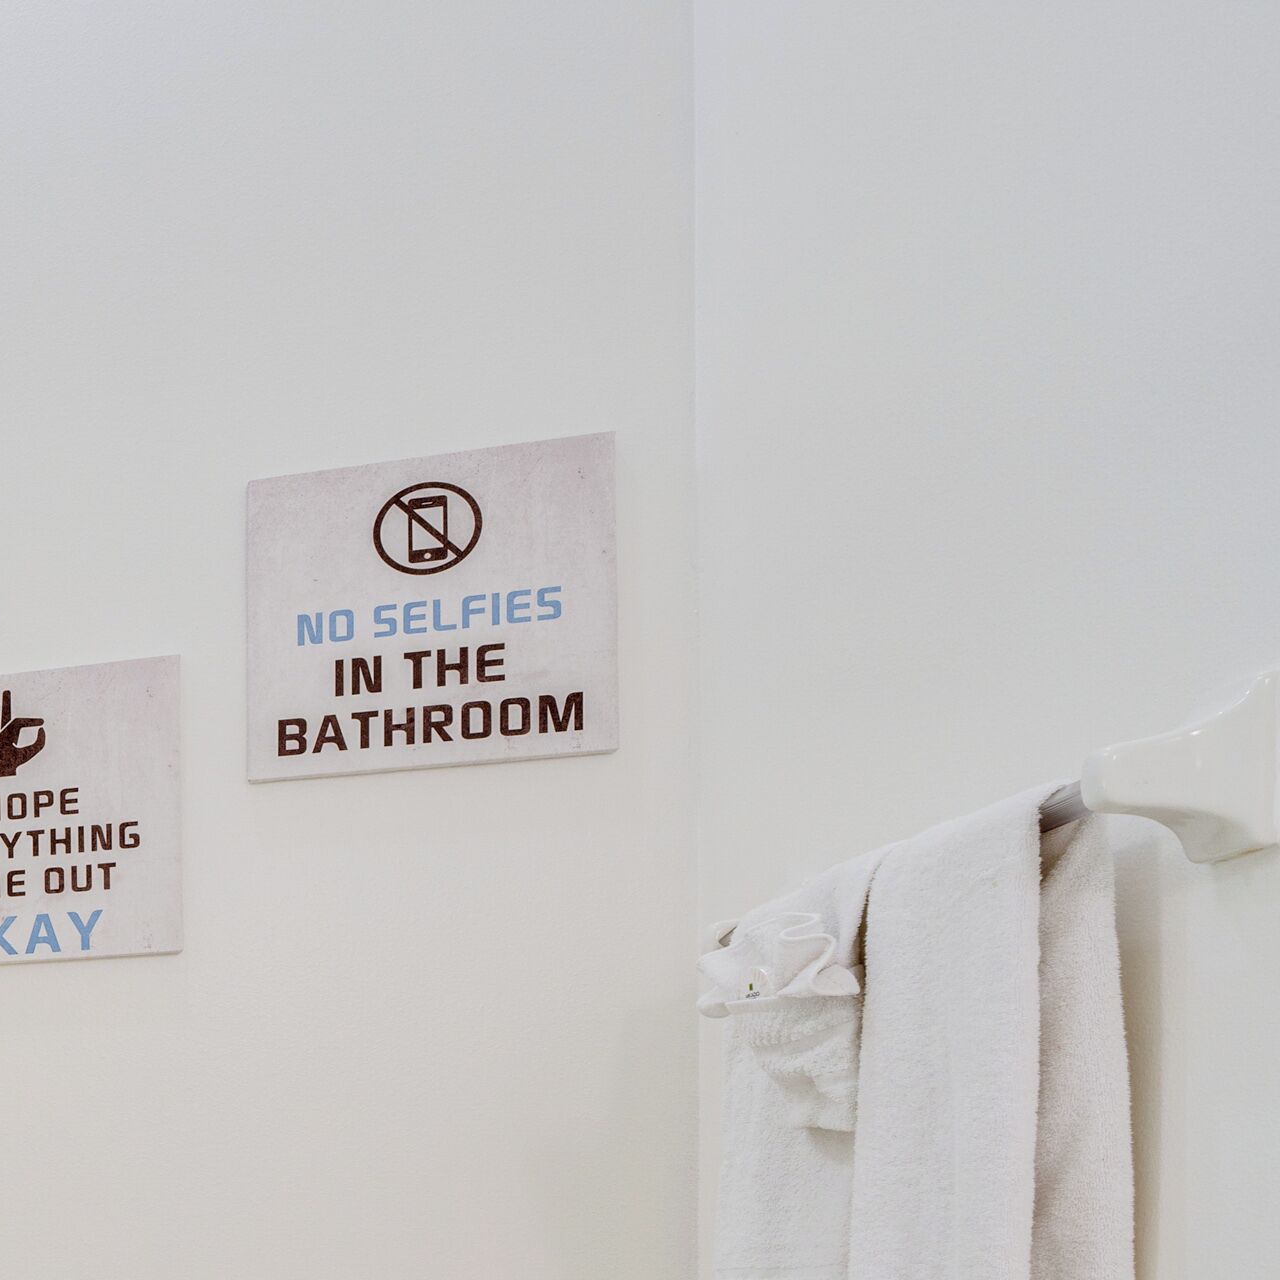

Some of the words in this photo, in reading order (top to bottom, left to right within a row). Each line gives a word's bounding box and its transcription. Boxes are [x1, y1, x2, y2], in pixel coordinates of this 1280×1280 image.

[298, 608, 354, 646] NO
[373, 586, 561, 638] SELFIES
[334, 655, 383, 698] IN
[403, 642, 506, 691] THE
[276, 690, 585, 758] BATHROOM
[44, 861, 117, 896] OUT
